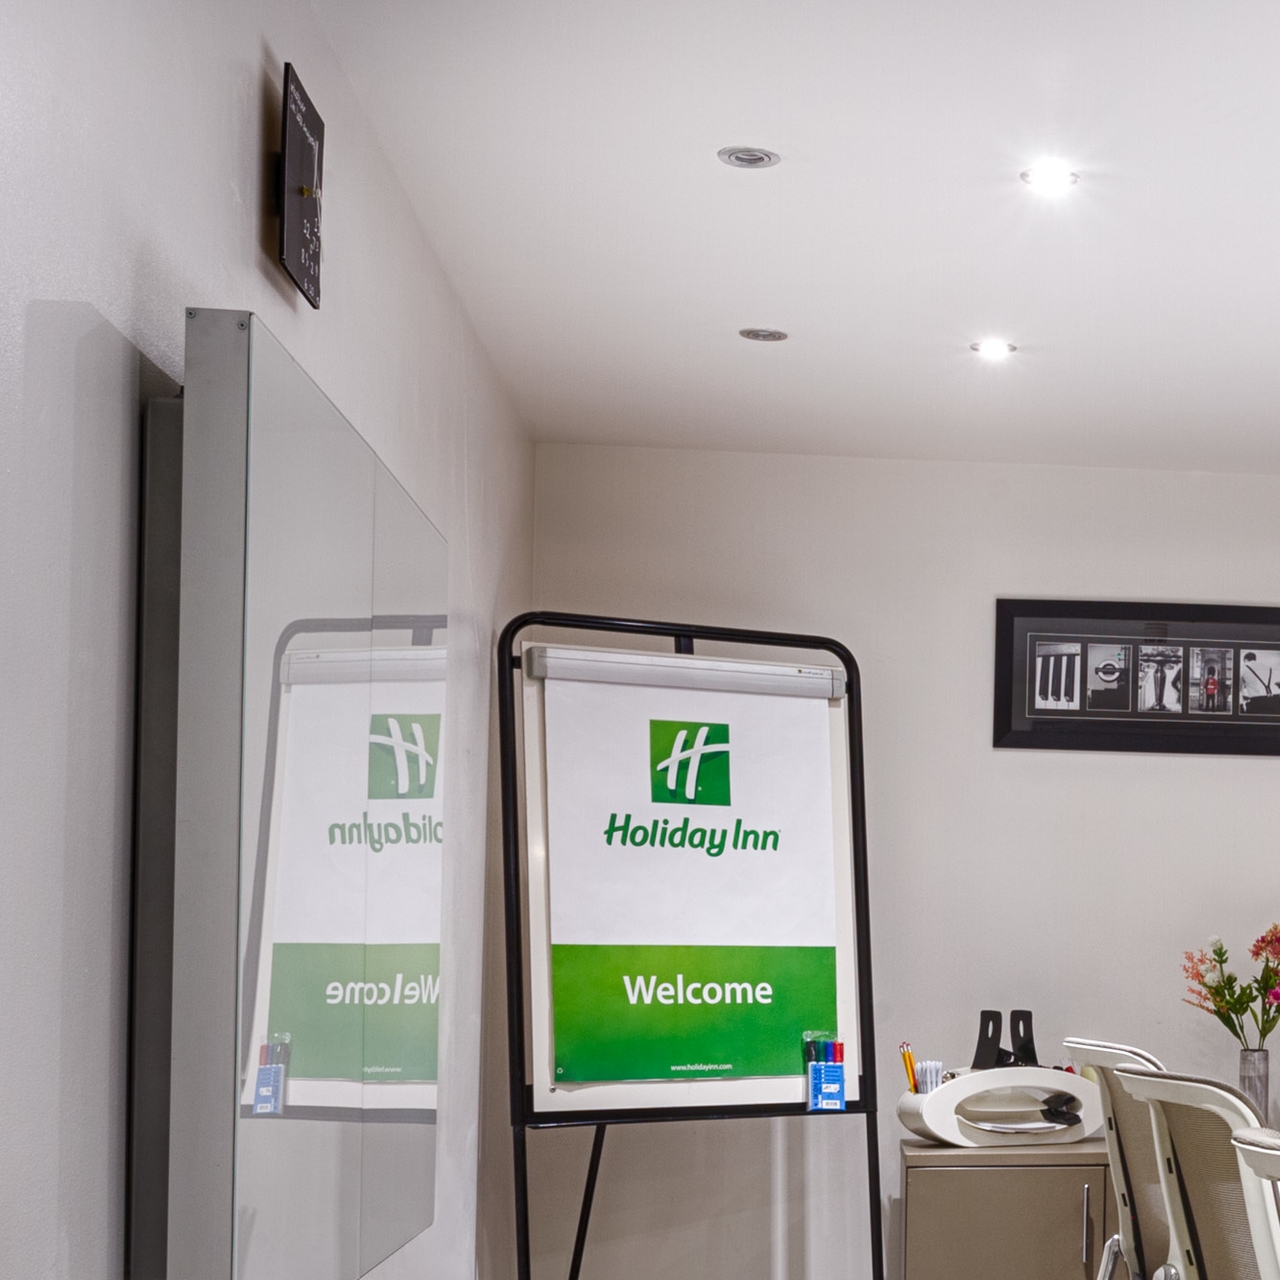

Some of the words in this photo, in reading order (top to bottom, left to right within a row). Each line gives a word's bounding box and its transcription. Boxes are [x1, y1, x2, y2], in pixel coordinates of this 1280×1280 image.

[603, 813, 728, 858] Holiday
[732, 818, 780, 851] Inn
[622, 973, 773, 1005] Welcome
[670, 1063, 733, 1072] www.holidayinn.com
